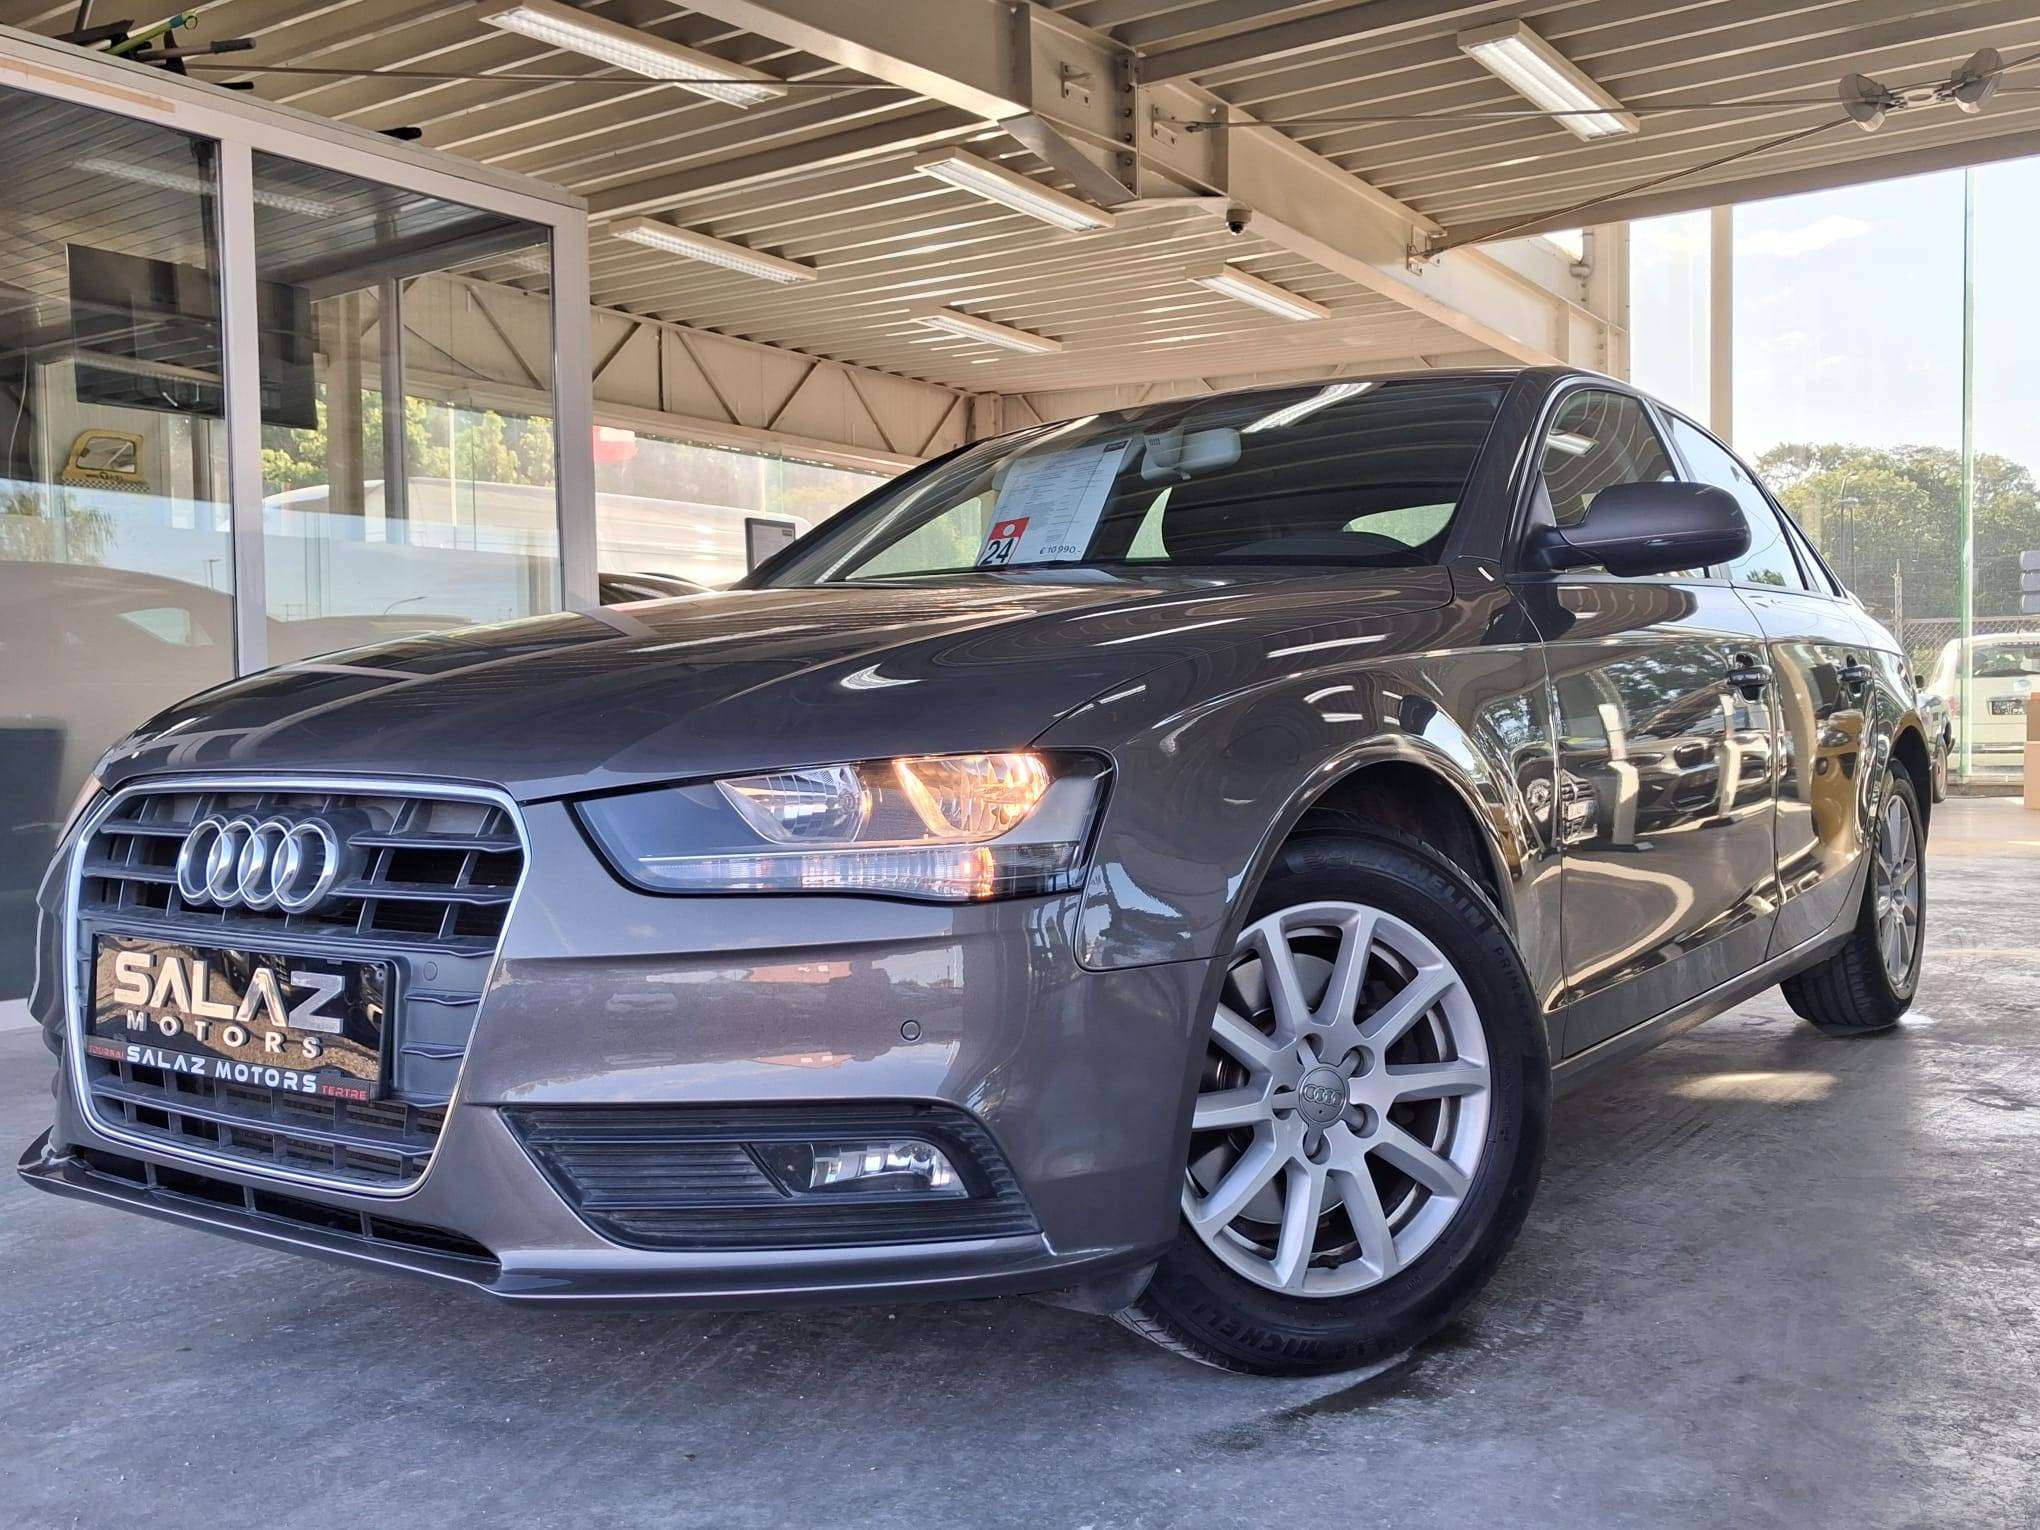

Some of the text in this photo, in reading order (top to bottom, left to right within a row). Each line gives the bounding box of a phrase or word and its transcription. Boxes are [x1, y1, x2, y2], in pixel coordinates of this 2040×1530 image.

[980, 539, 1013, 566] 24
[114, 951, 345, 1034] SALAZ
[126, 1009, 323, 1059] MOTORS
[126, 1046, 206, 1075] SALAZ
[215, 1060, 317, 1093] MOTORS
[321, 1084, 368, 1100] TERTRE
